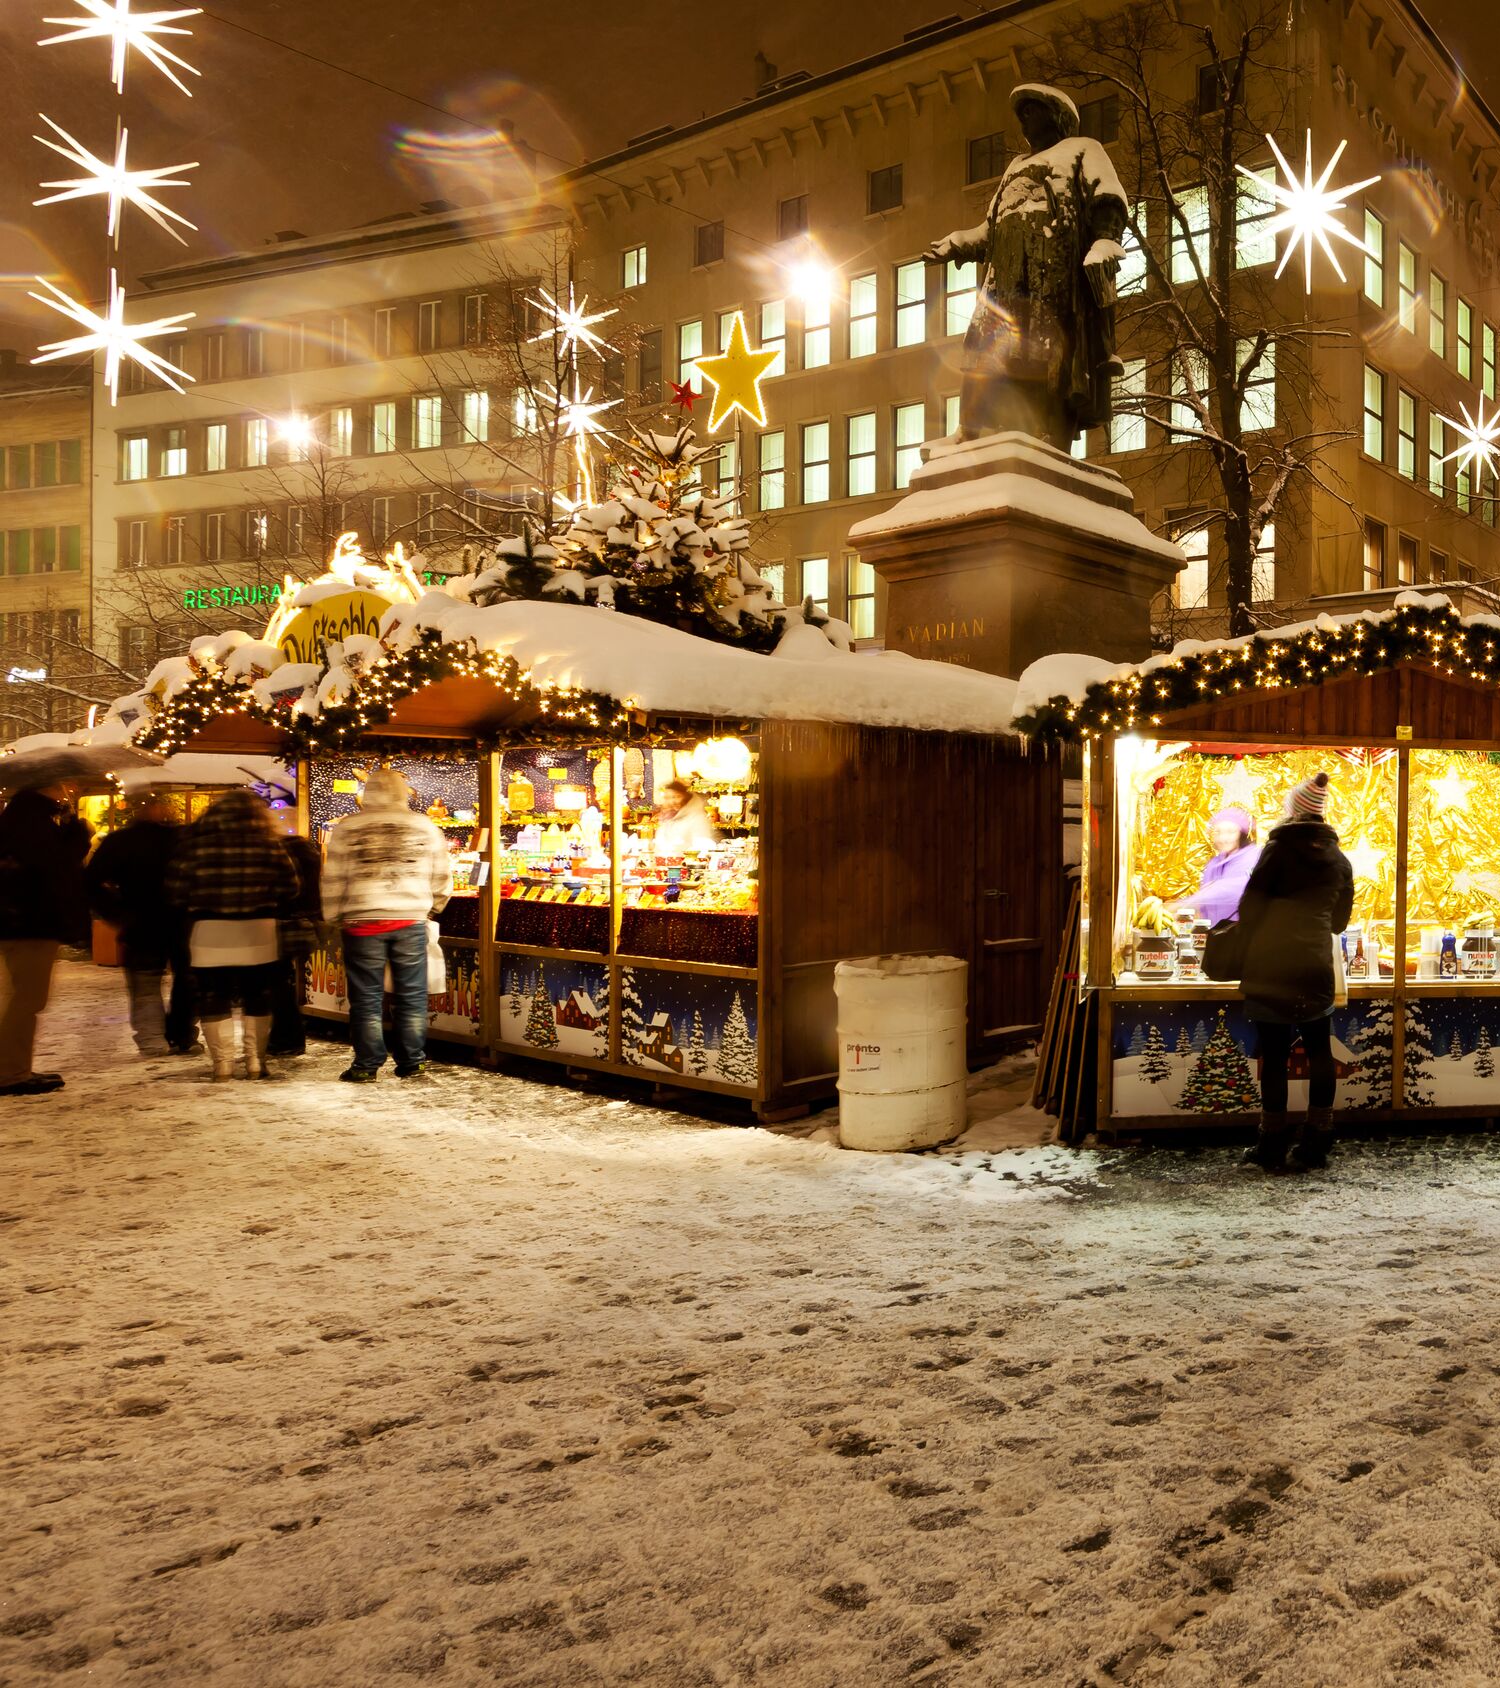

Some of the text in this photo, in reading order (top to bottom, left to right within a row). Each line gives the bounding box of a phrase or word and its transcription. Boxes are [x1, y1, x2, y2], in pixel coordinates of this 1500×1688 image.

[183, 582, 304, 609] RESTAURA
[907, 617, 984, 644] VADIAN
[1140, 952, 1168, 960] nutella
[846, 1043, 881, 1054] pronto
